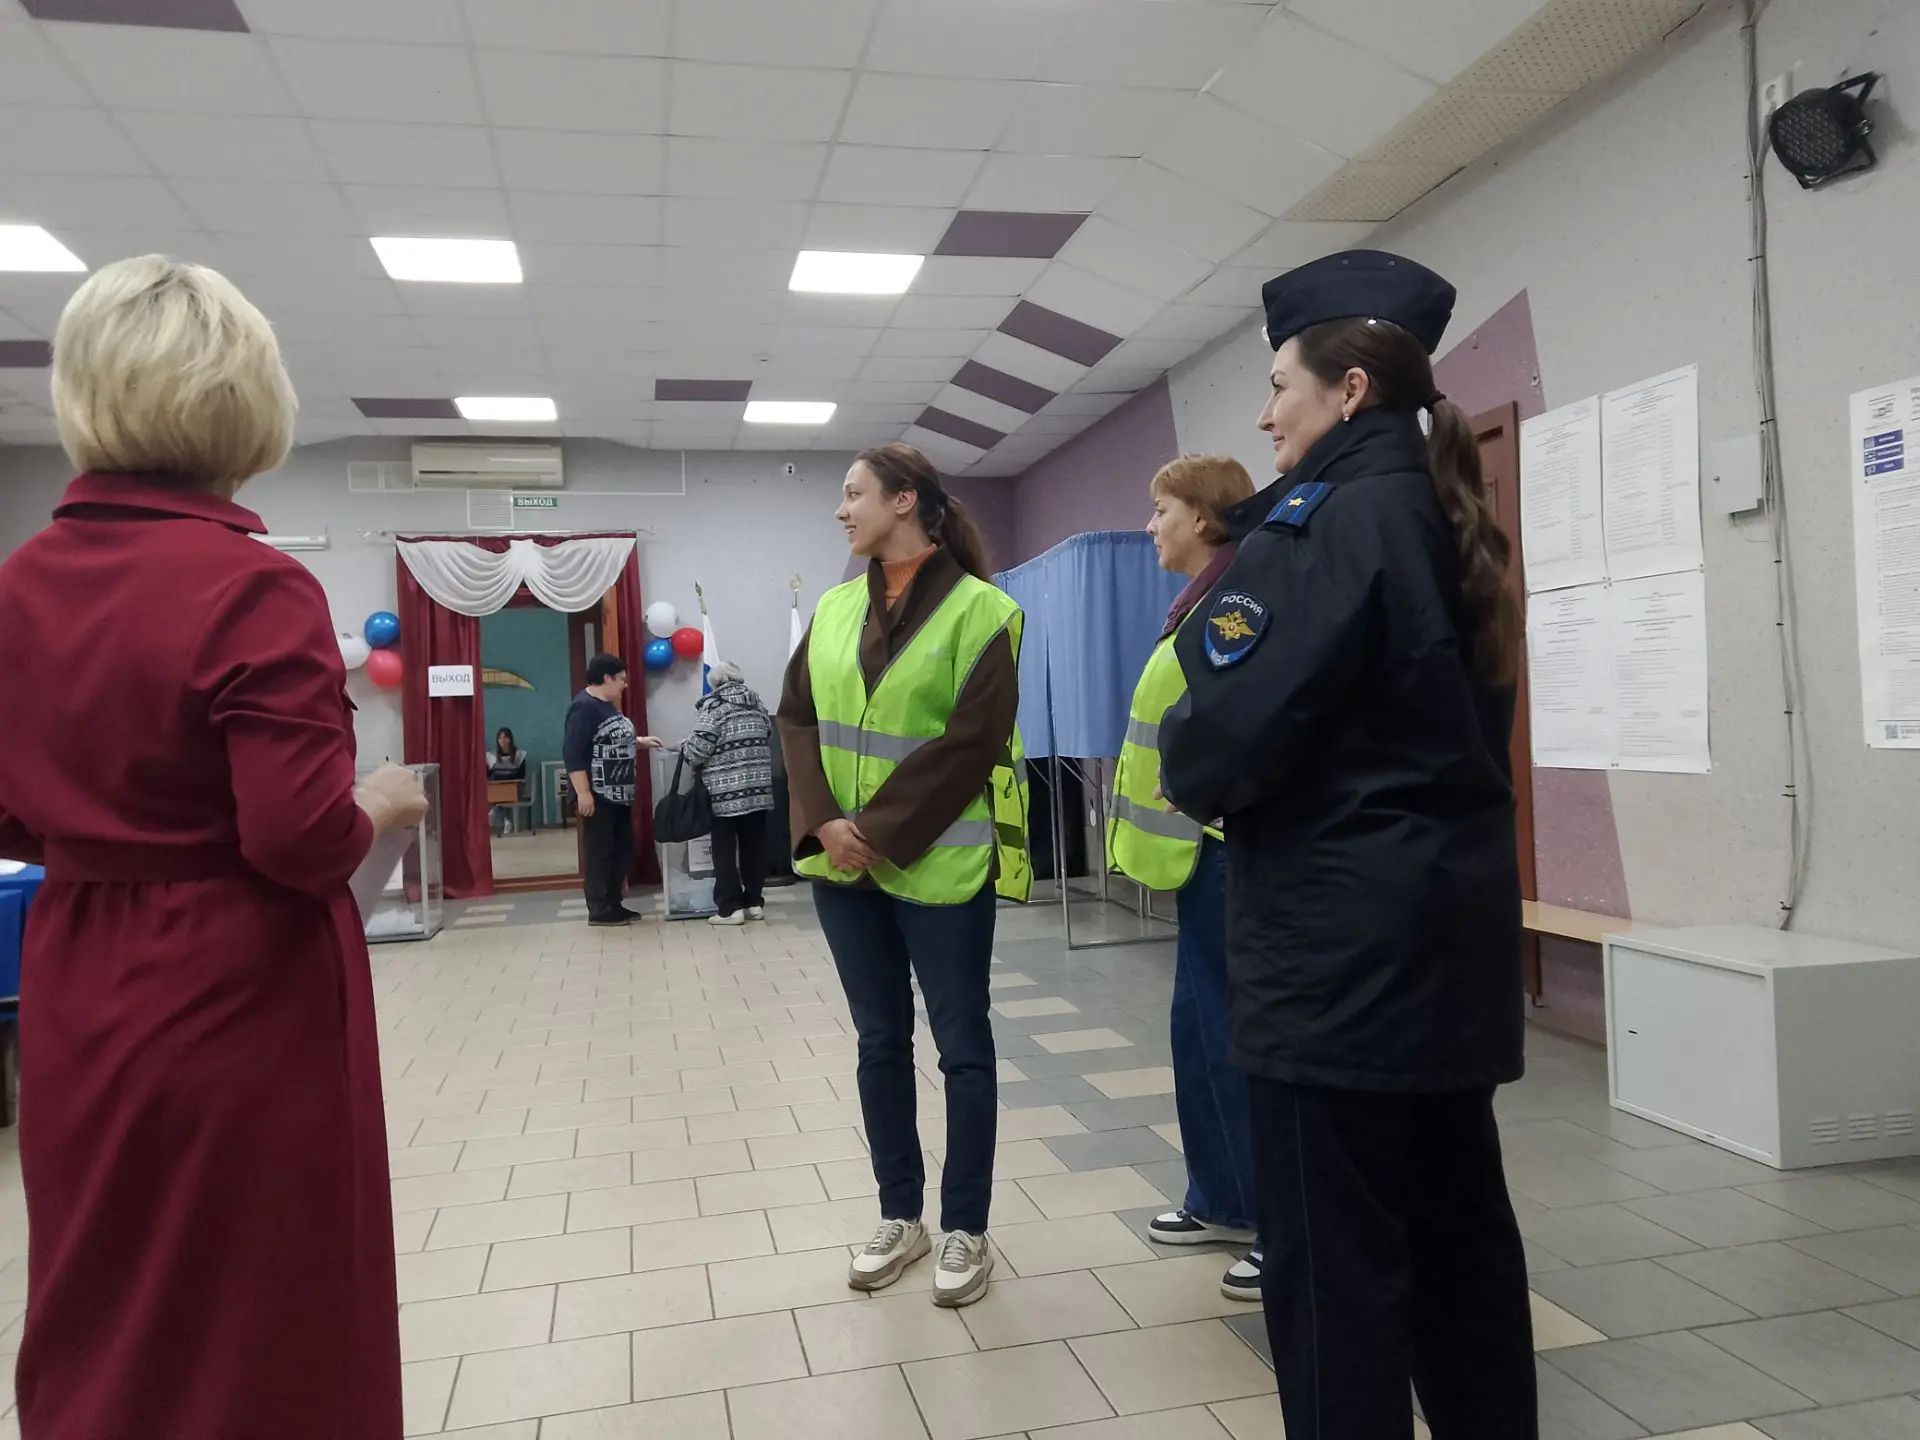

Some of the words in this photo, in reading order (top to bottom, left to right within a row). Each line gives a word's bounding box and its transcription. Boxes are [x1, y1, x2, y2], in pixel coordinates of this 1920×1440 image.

[517, 498, 553, 506] ВЫХОД
[1220, 595, 1263, 617] РОССИЯ
[432, 673, 471, 683] ВЫХОД
